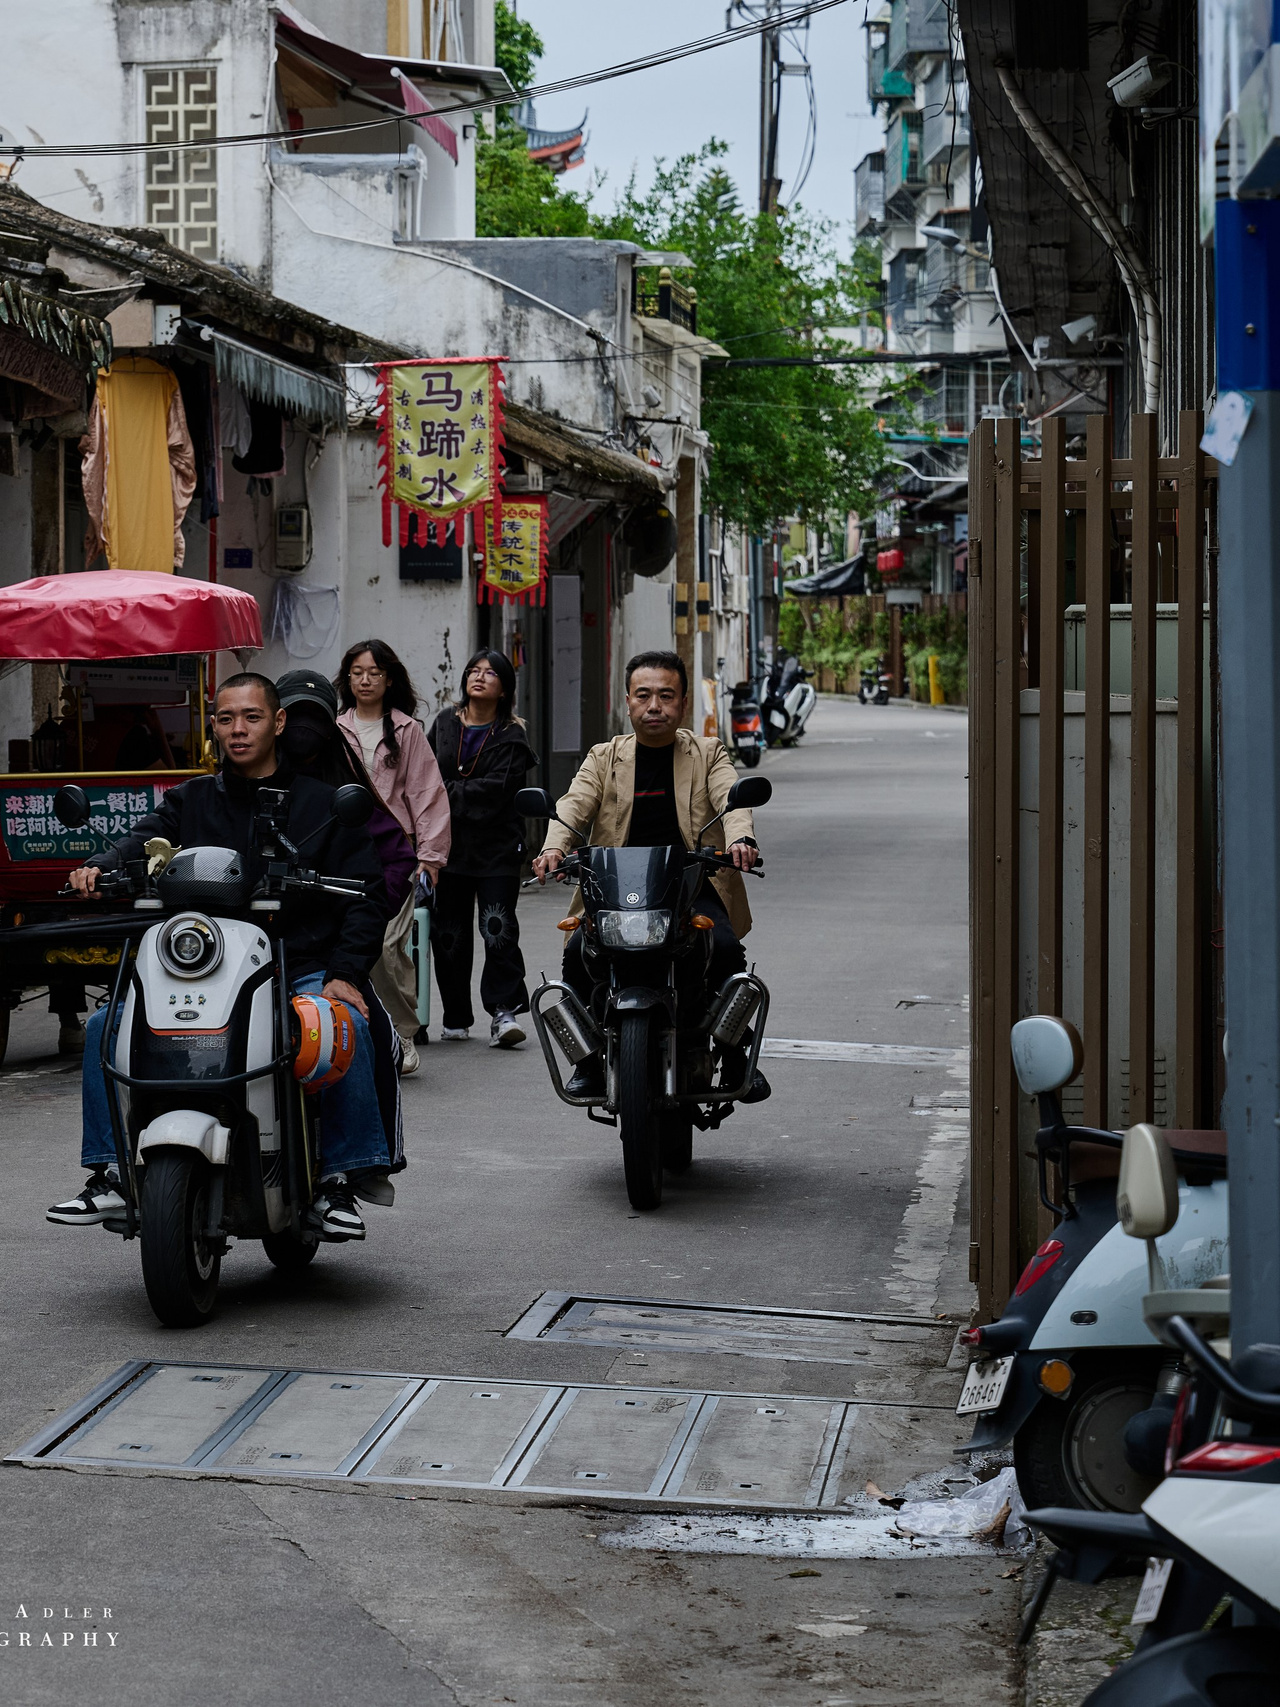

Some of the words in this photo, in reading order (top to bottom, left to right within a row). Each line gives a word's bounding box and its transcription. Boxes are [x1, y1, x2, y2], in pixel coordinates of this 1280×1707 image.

[416, 371, 466, 508] 马蹄水
[470, 388, 487, 480] 清热去火
[499, 520, 525, 583] 传统木雕
[961, 1382, 1002, 1407] 266461
